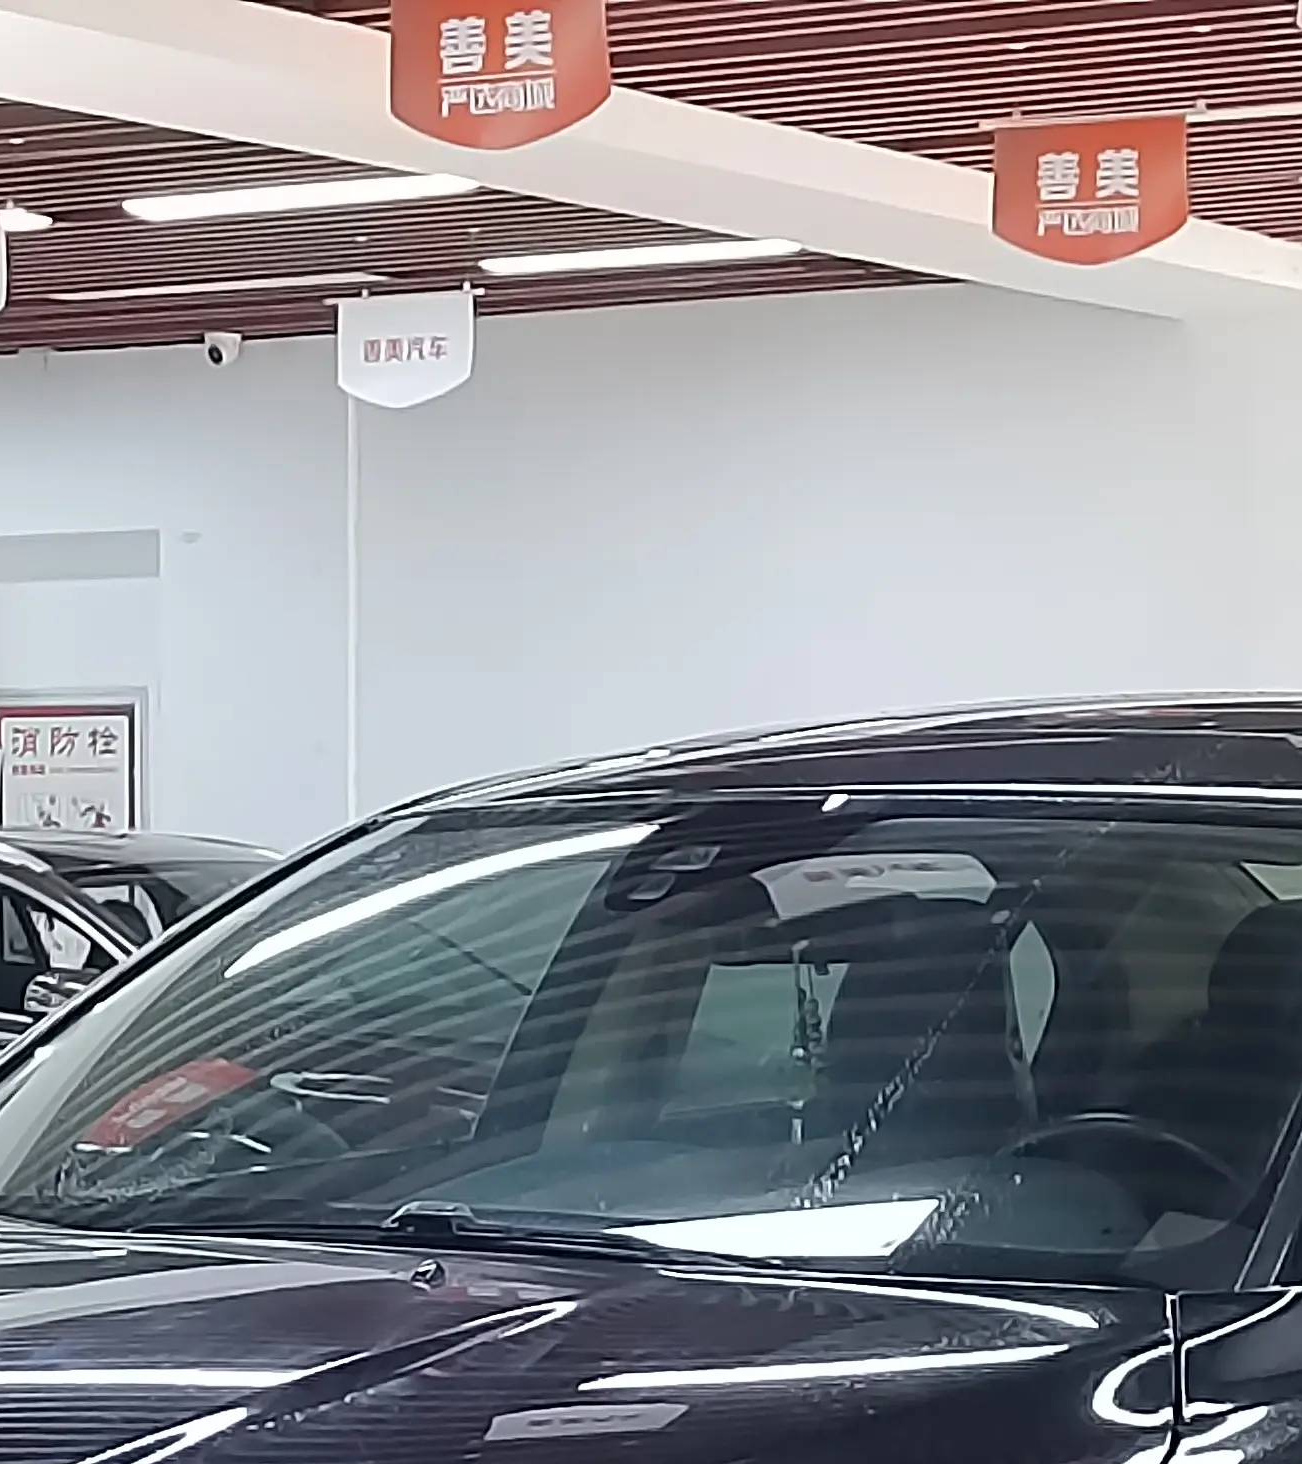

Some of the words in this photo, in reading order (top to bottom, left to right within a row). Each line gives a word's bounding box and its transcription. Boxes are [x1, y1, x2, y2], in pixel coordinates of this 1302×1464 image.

[440, 10, 554, 75] 善美
[1037, 148, 1140, 200] 善美
[11, 726, 120, 758] 消防栓
